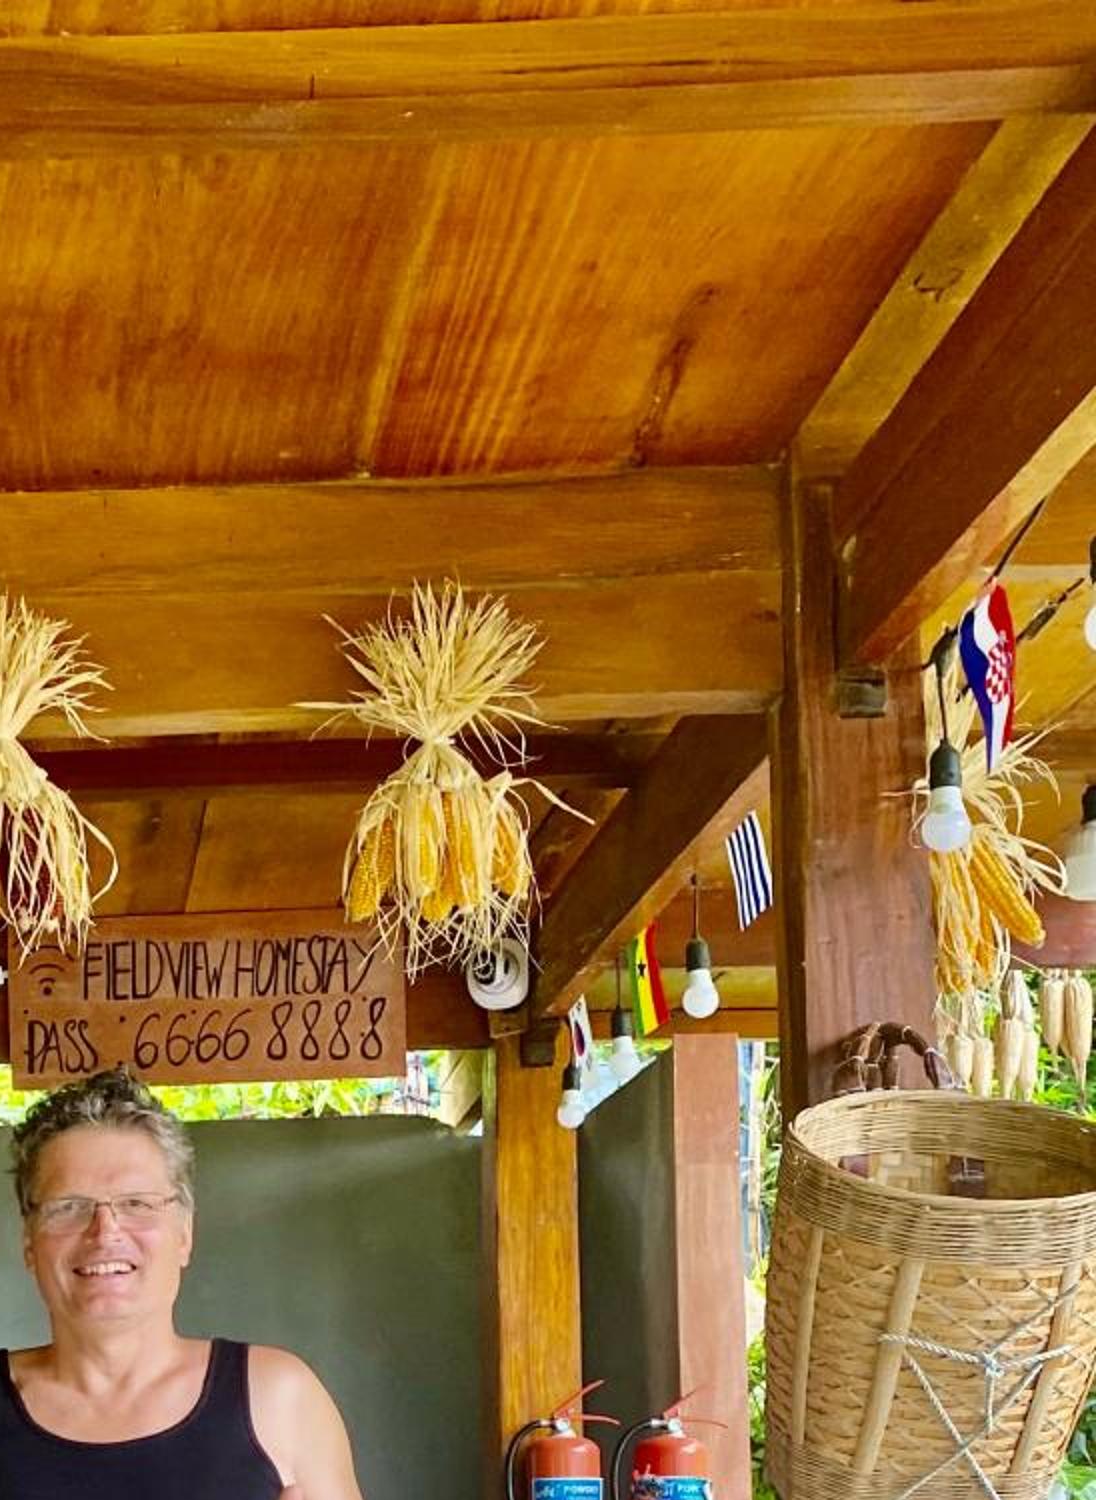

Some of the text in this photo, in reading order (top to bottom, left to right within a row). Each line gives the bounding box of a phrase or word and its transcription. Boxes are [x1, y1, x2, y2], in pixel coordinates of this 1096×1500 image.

[234, 934, 383, 998] HOMESTAY
[133, 1008, 254, 1070] 6666
[265, 996, 387, 1062] 8888
